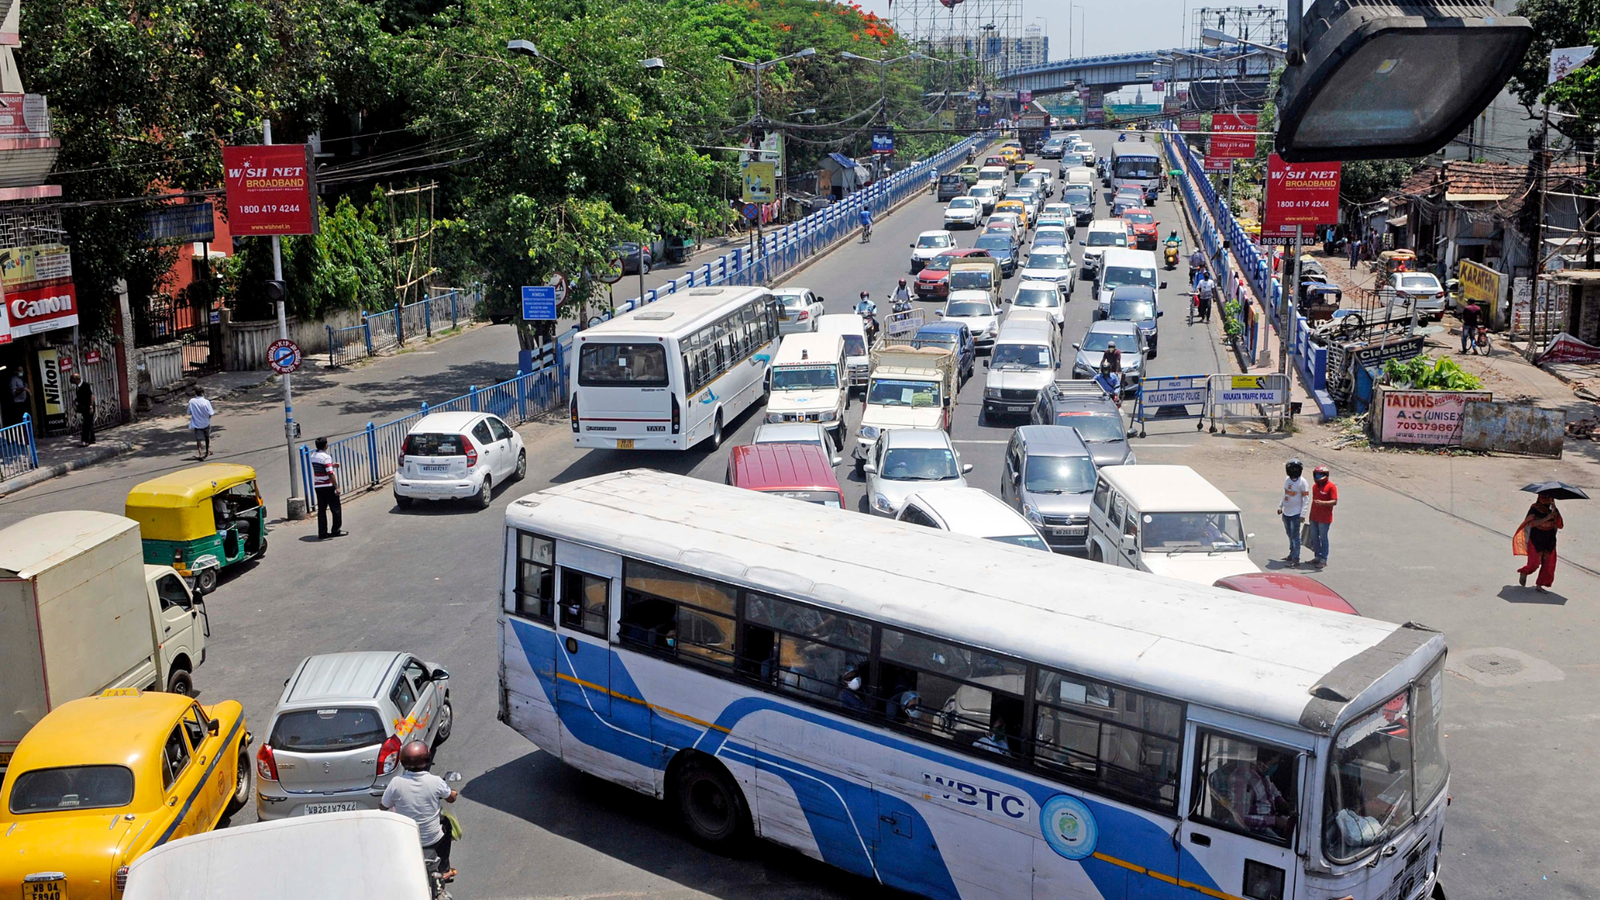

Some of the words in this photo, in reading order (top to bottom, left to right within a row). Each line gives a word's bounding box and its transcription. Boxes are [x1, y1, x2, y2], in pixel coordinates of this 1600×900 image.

[272, 167, 303, 176] NET
[1309, 171, 1337, 179] NET
[246, 178, 304, 188] BROADBAND
[240, 205, 259, 214] 1800
[262, 204, 277, 213] 419
[11, 294, 72, 319] Canon
[1360, 342, 1417, 359] Classick
[44, 360, 60, 404] Nikon
[1148, 393, 1167, 403] KOLKATA
[1168, 392, 1185, 401] TRAFFIC
[1185, 391, 1200, 401] POLICE
[1386, 394, 1434, 408] TATON'S
[47, 883, 58, 891] 04
